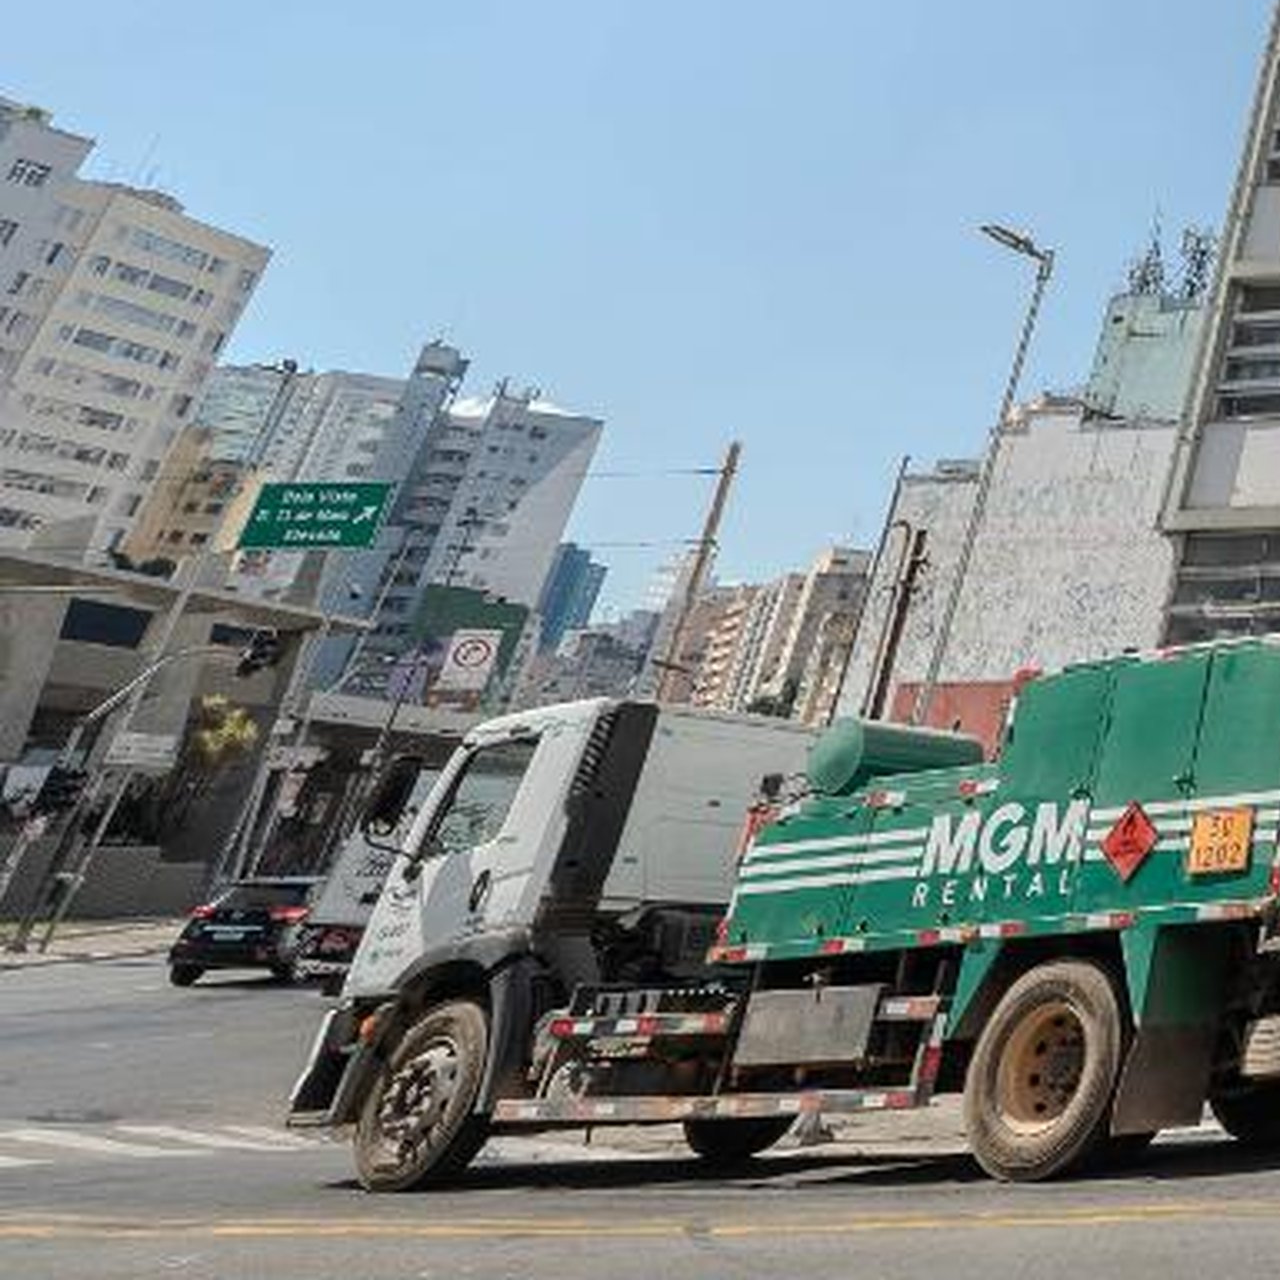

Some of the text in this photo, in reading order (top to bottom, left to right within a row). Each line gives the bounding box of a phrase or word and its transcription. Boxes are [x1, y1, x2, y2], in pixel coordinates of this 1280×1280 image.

[922, 799, 1091, 875] MGM
[1196, 841, 1242, 868] 1202
[912, 869, 1071, 908] RENTAL
